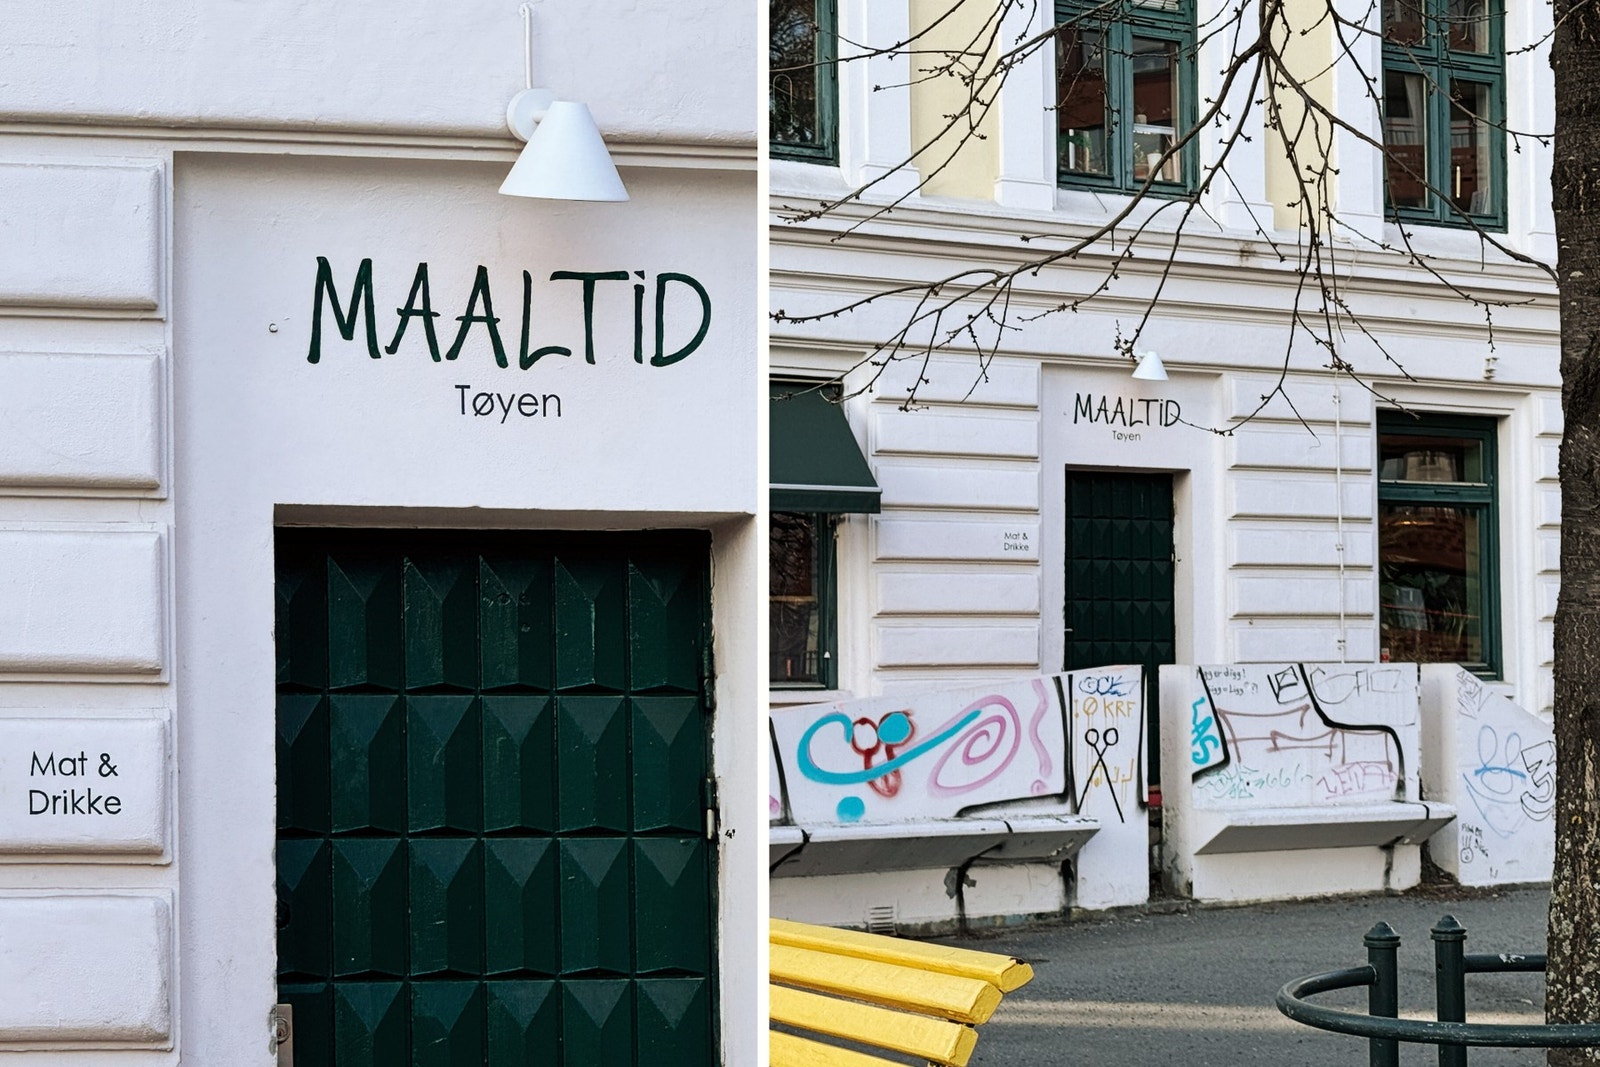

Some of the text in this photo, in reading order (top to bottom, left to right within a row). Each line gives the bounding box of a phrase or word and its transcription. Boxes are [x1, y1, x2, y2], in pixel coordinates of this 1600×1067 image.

[454, 384, 562, 424] Tøyen
[1112, 430, 1141, 441] Tøyen
[1004, 532, 1029, 540] Mat &
[1003, 542, 1030, 551] Drikke
[30, 750, 119, 778] Mat &
[28, 787, 122, 815] Drikke
